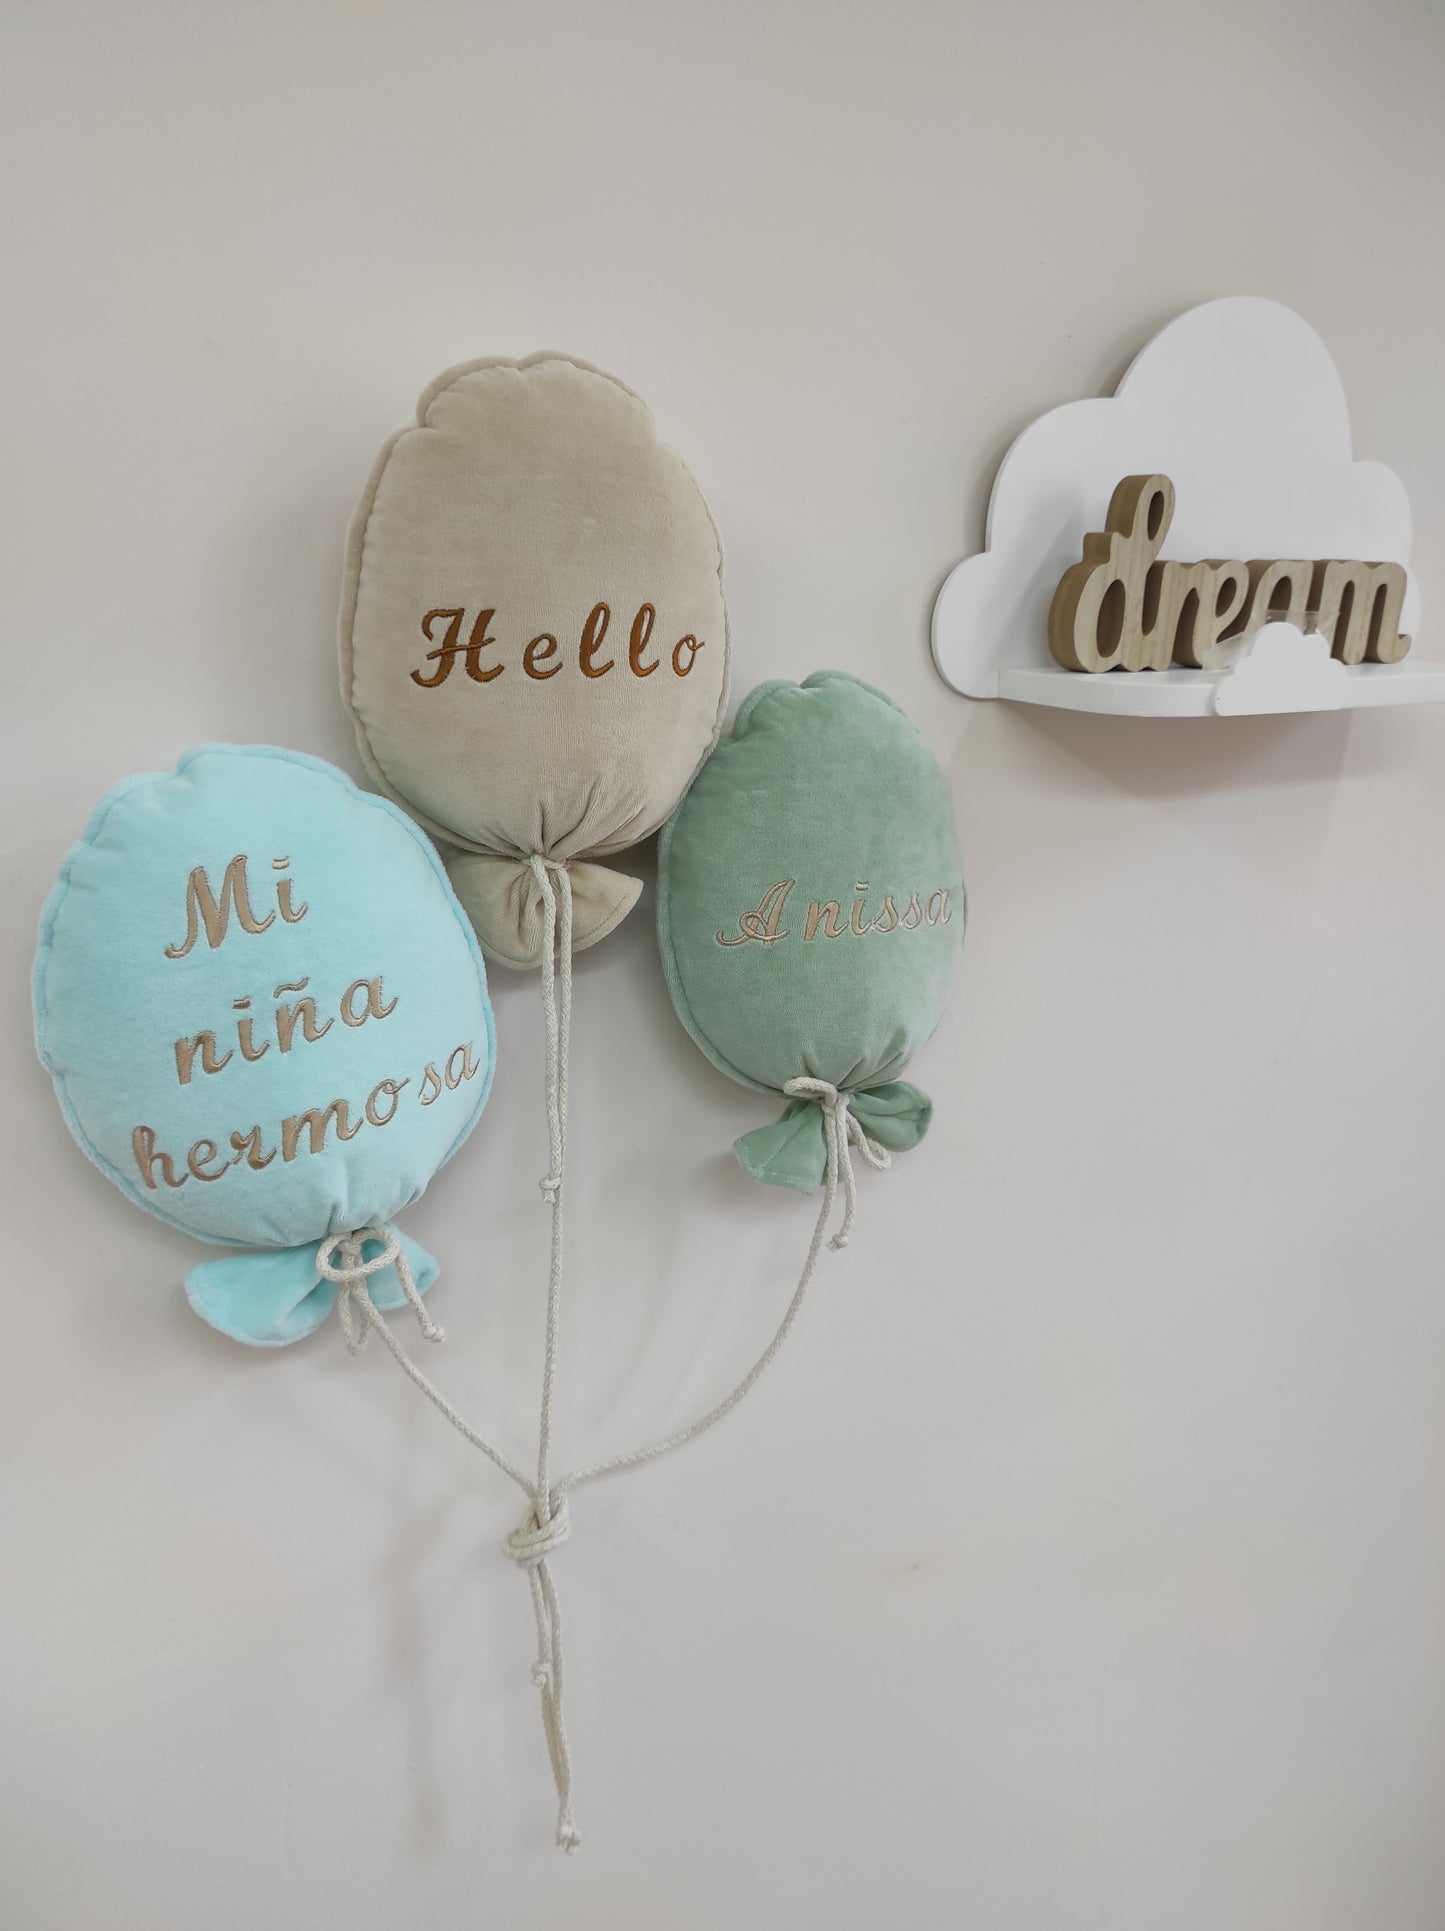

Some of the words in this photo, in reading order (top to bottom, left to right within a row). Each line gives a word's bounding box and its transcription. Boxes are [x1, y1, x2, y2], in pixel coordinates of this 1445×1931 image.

[1052, 474, 1412, 674] dream
[410, 601, 706, 688] Hello
[164, 854, 309, 959] Mi
[715, 878, 952, 946] Anissa
[174, 975, 399, 1085] niña
[132, 1040, 481, 1189] hermosa
